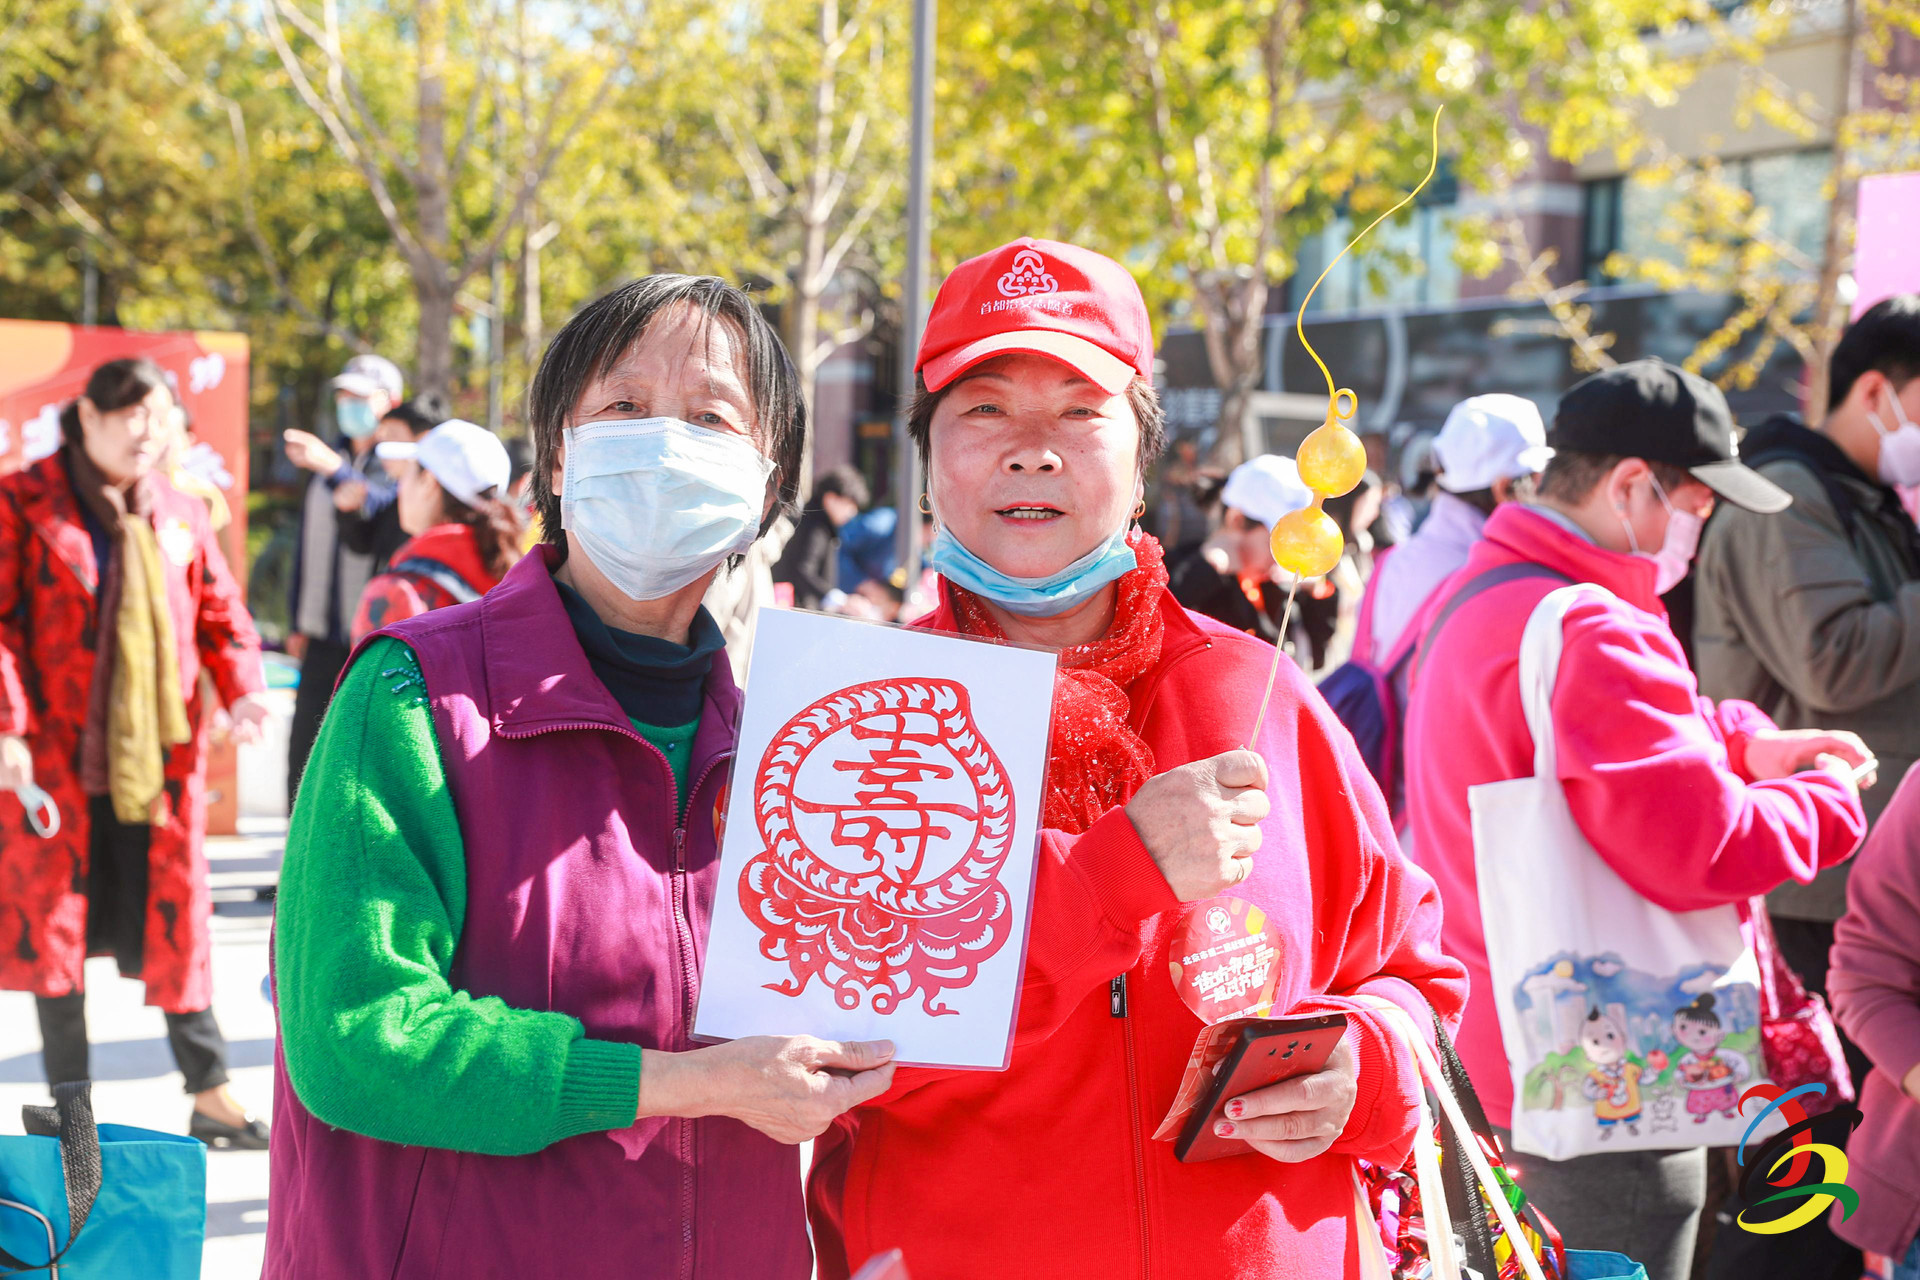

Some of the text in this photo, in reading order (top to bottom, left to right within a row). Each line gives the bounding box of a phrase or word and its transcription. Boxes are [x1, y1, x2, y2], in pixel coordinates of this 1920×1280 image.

[980, 299, 1073, 315] 首都治安志愿者
